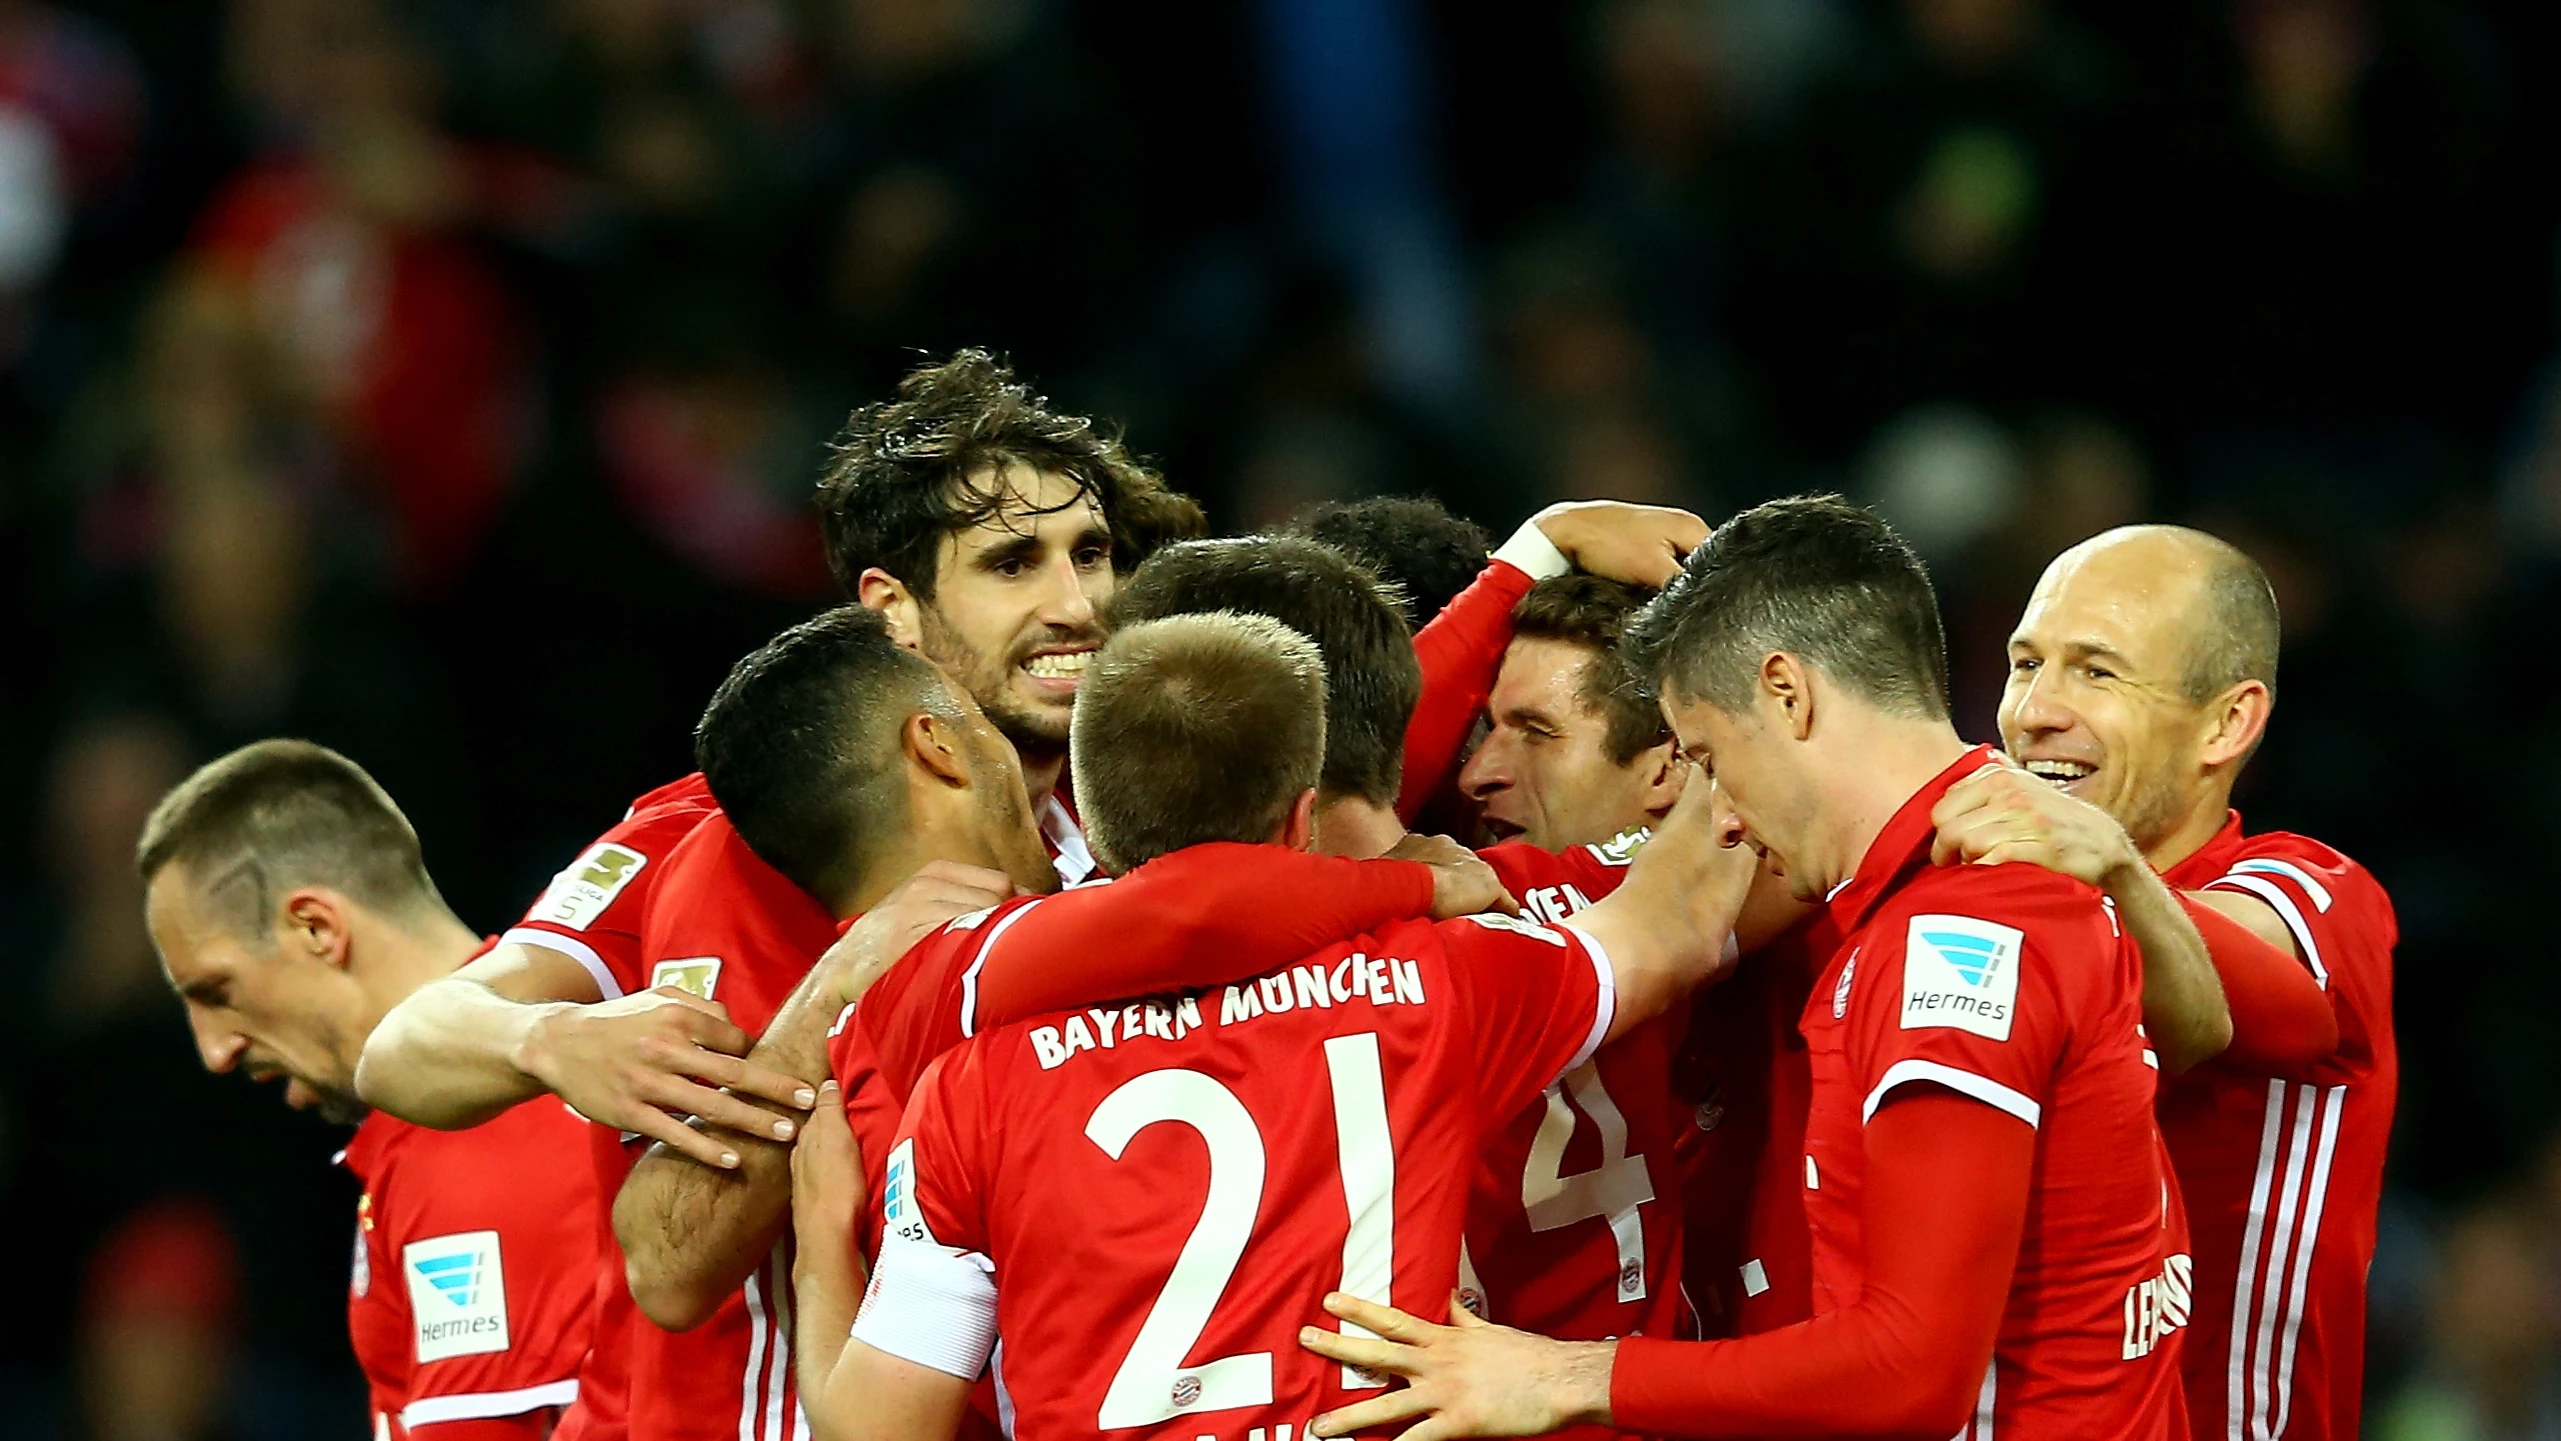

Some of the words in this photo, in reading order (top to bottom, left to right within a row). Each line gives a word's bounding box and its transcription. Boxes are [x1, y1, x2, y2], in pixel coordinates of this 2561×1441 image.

[1908, 991, 2007, 1020] Hermes
[1029, 997, 1203, 1071] BAYERN
[1084, 1031, 1397, 1431] 21
[421, 1315, 500, 1343] Hermes
